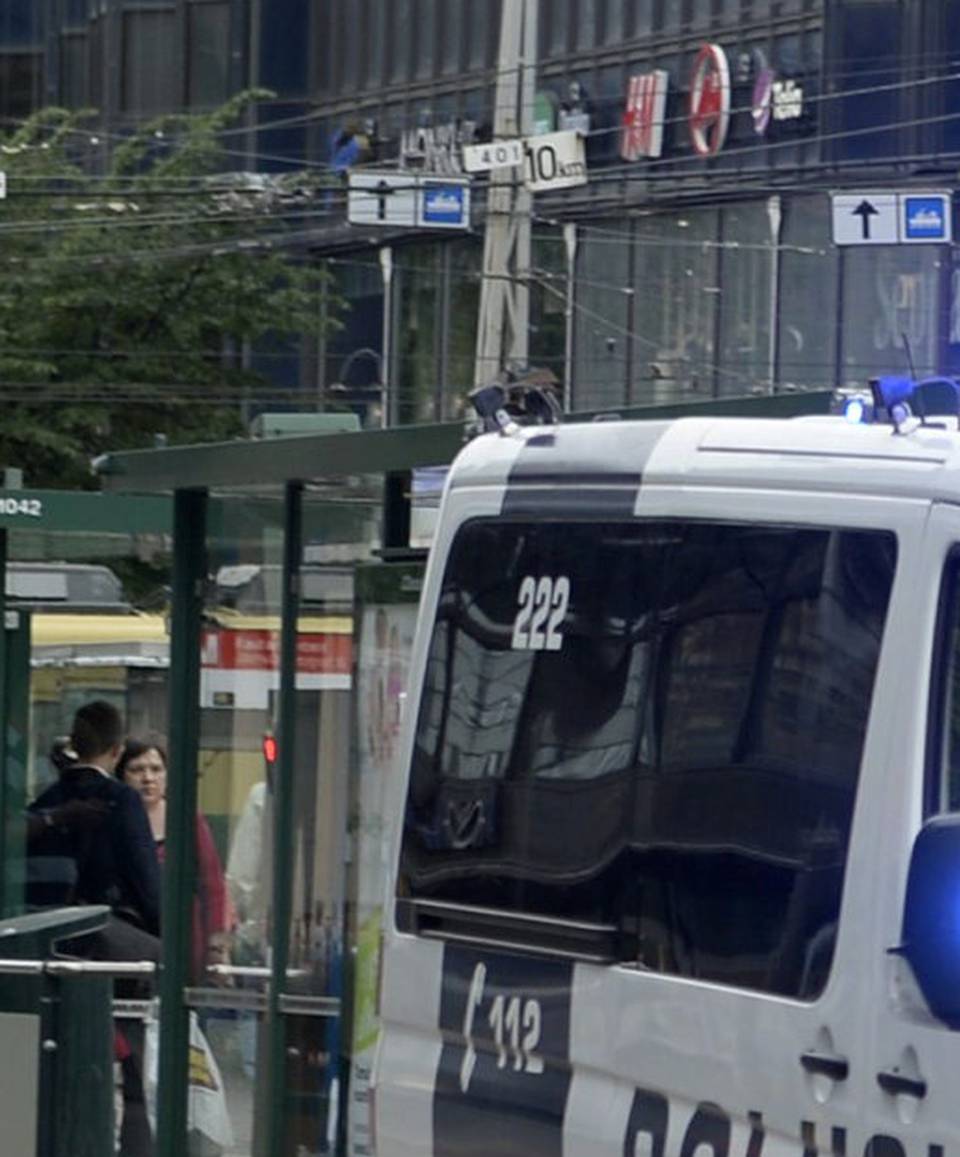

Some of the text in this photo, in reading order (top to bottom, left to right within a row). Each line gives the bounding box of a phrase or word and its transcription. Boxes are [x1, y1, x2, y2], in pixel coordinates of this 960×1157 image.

[524, 145, 557, 183] 10
[511, 575, 570, 650] 222
[488, 995, 545, 1074] 112
